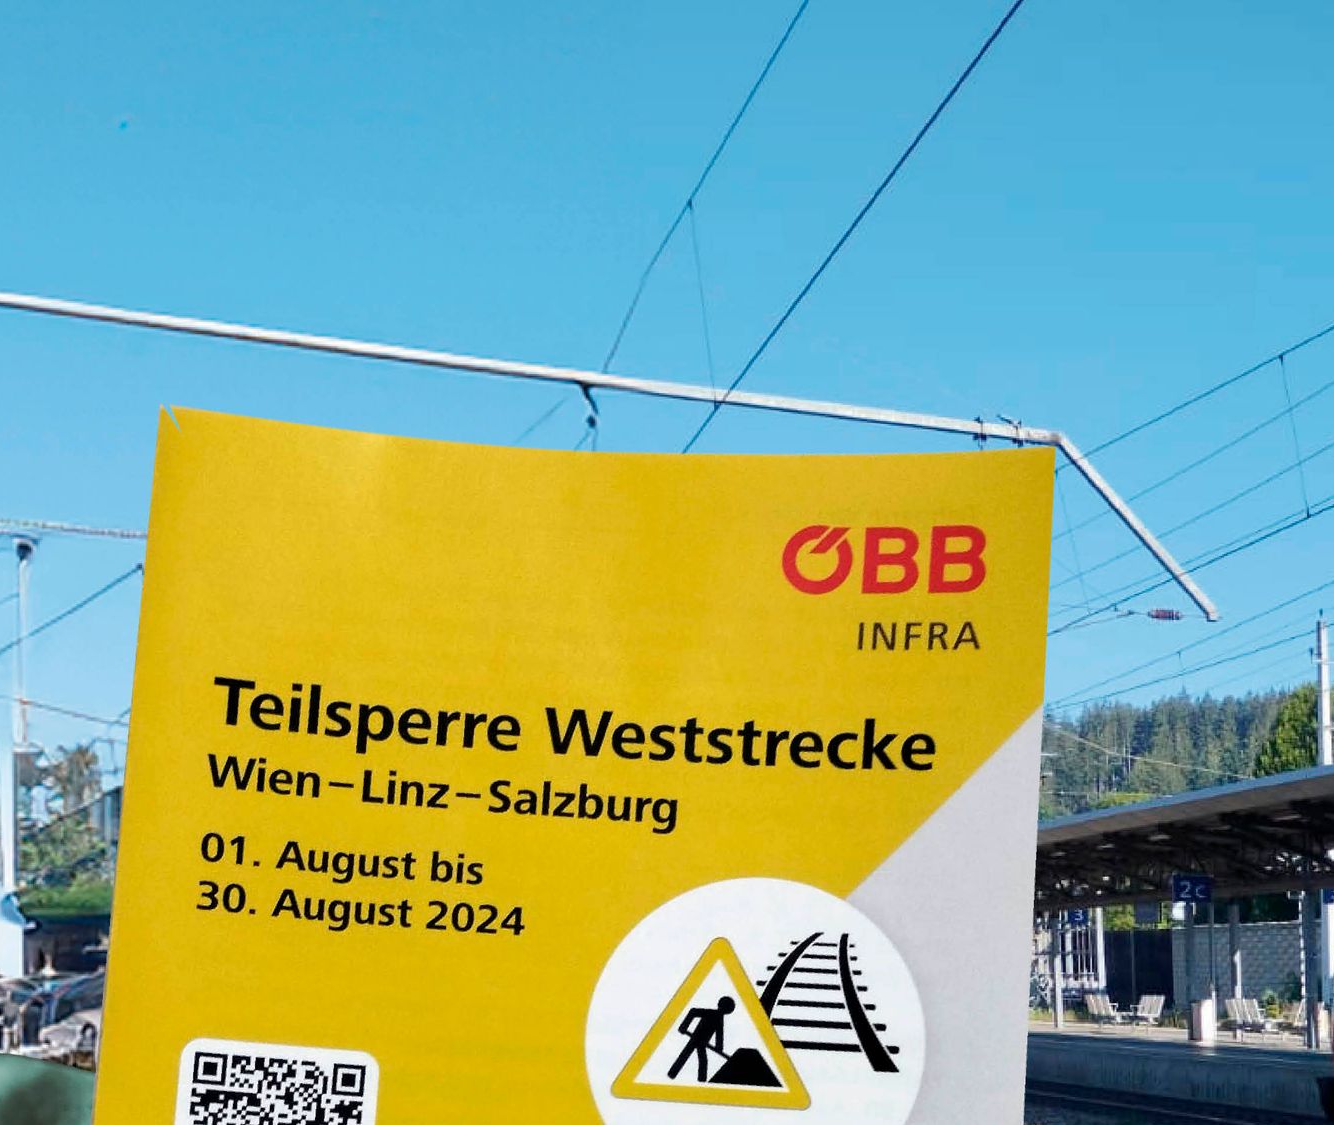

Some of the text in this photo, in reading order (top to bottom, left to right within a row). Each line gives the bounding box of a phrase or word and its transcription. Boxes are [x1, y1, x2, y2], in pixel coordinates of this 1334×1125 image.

[781, 524, 987, 596] ÖBB
[856, 620, 982, 652] INFRA
[213, 676, 937, 772] Teilsperre Weststrecke
[200, 832, 484, 886] 01. August bis
[196, 880, 526, 936] 30. August 2024
